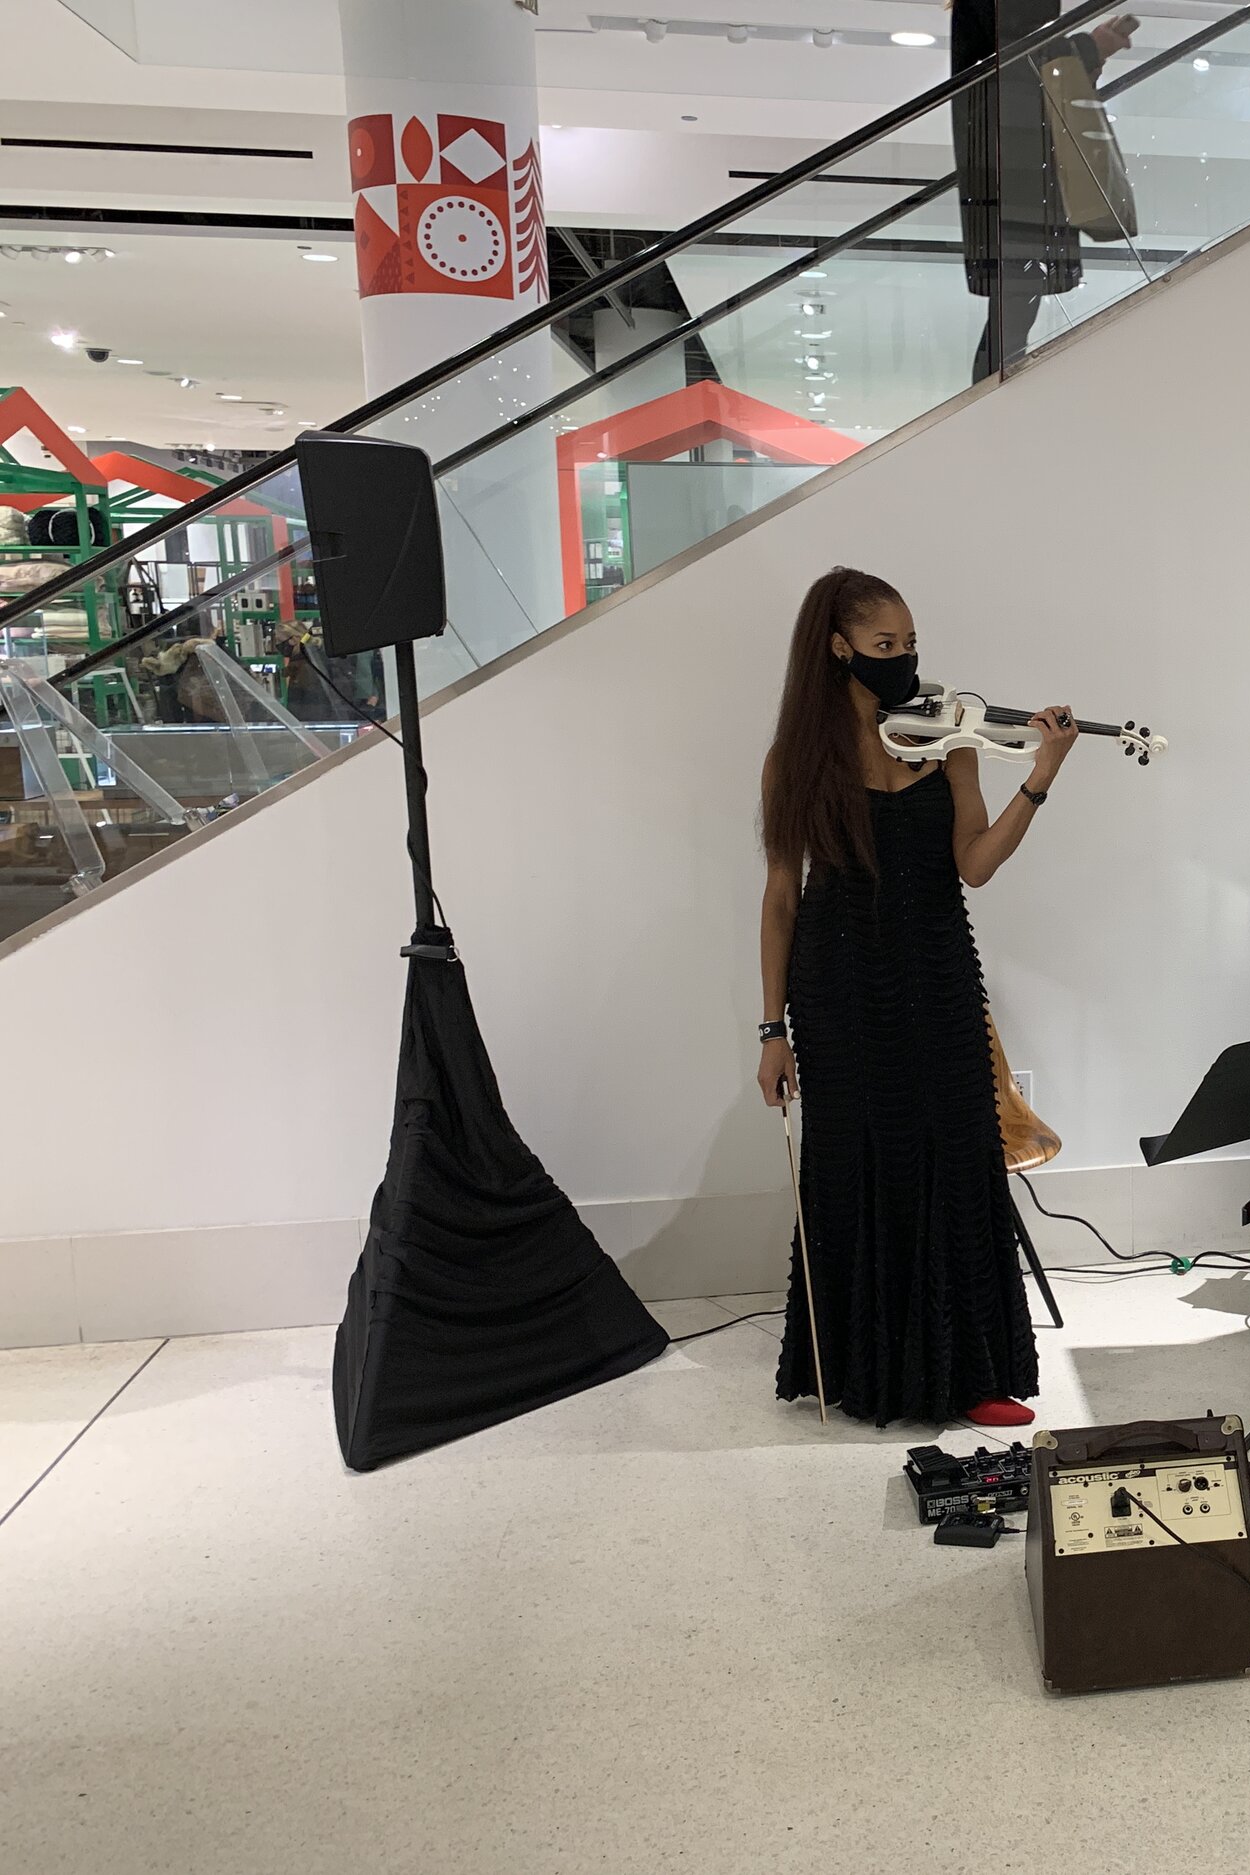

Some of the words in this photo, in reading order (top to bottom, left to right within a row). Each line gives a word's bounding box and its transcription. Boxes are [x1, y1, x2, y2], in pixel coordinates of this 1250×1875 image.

[1058, 1472, 1119, 1484] acoustic
[936, 1495, 969, 1507] BOSS
[927, 1506, 956, 1517] ME-70
